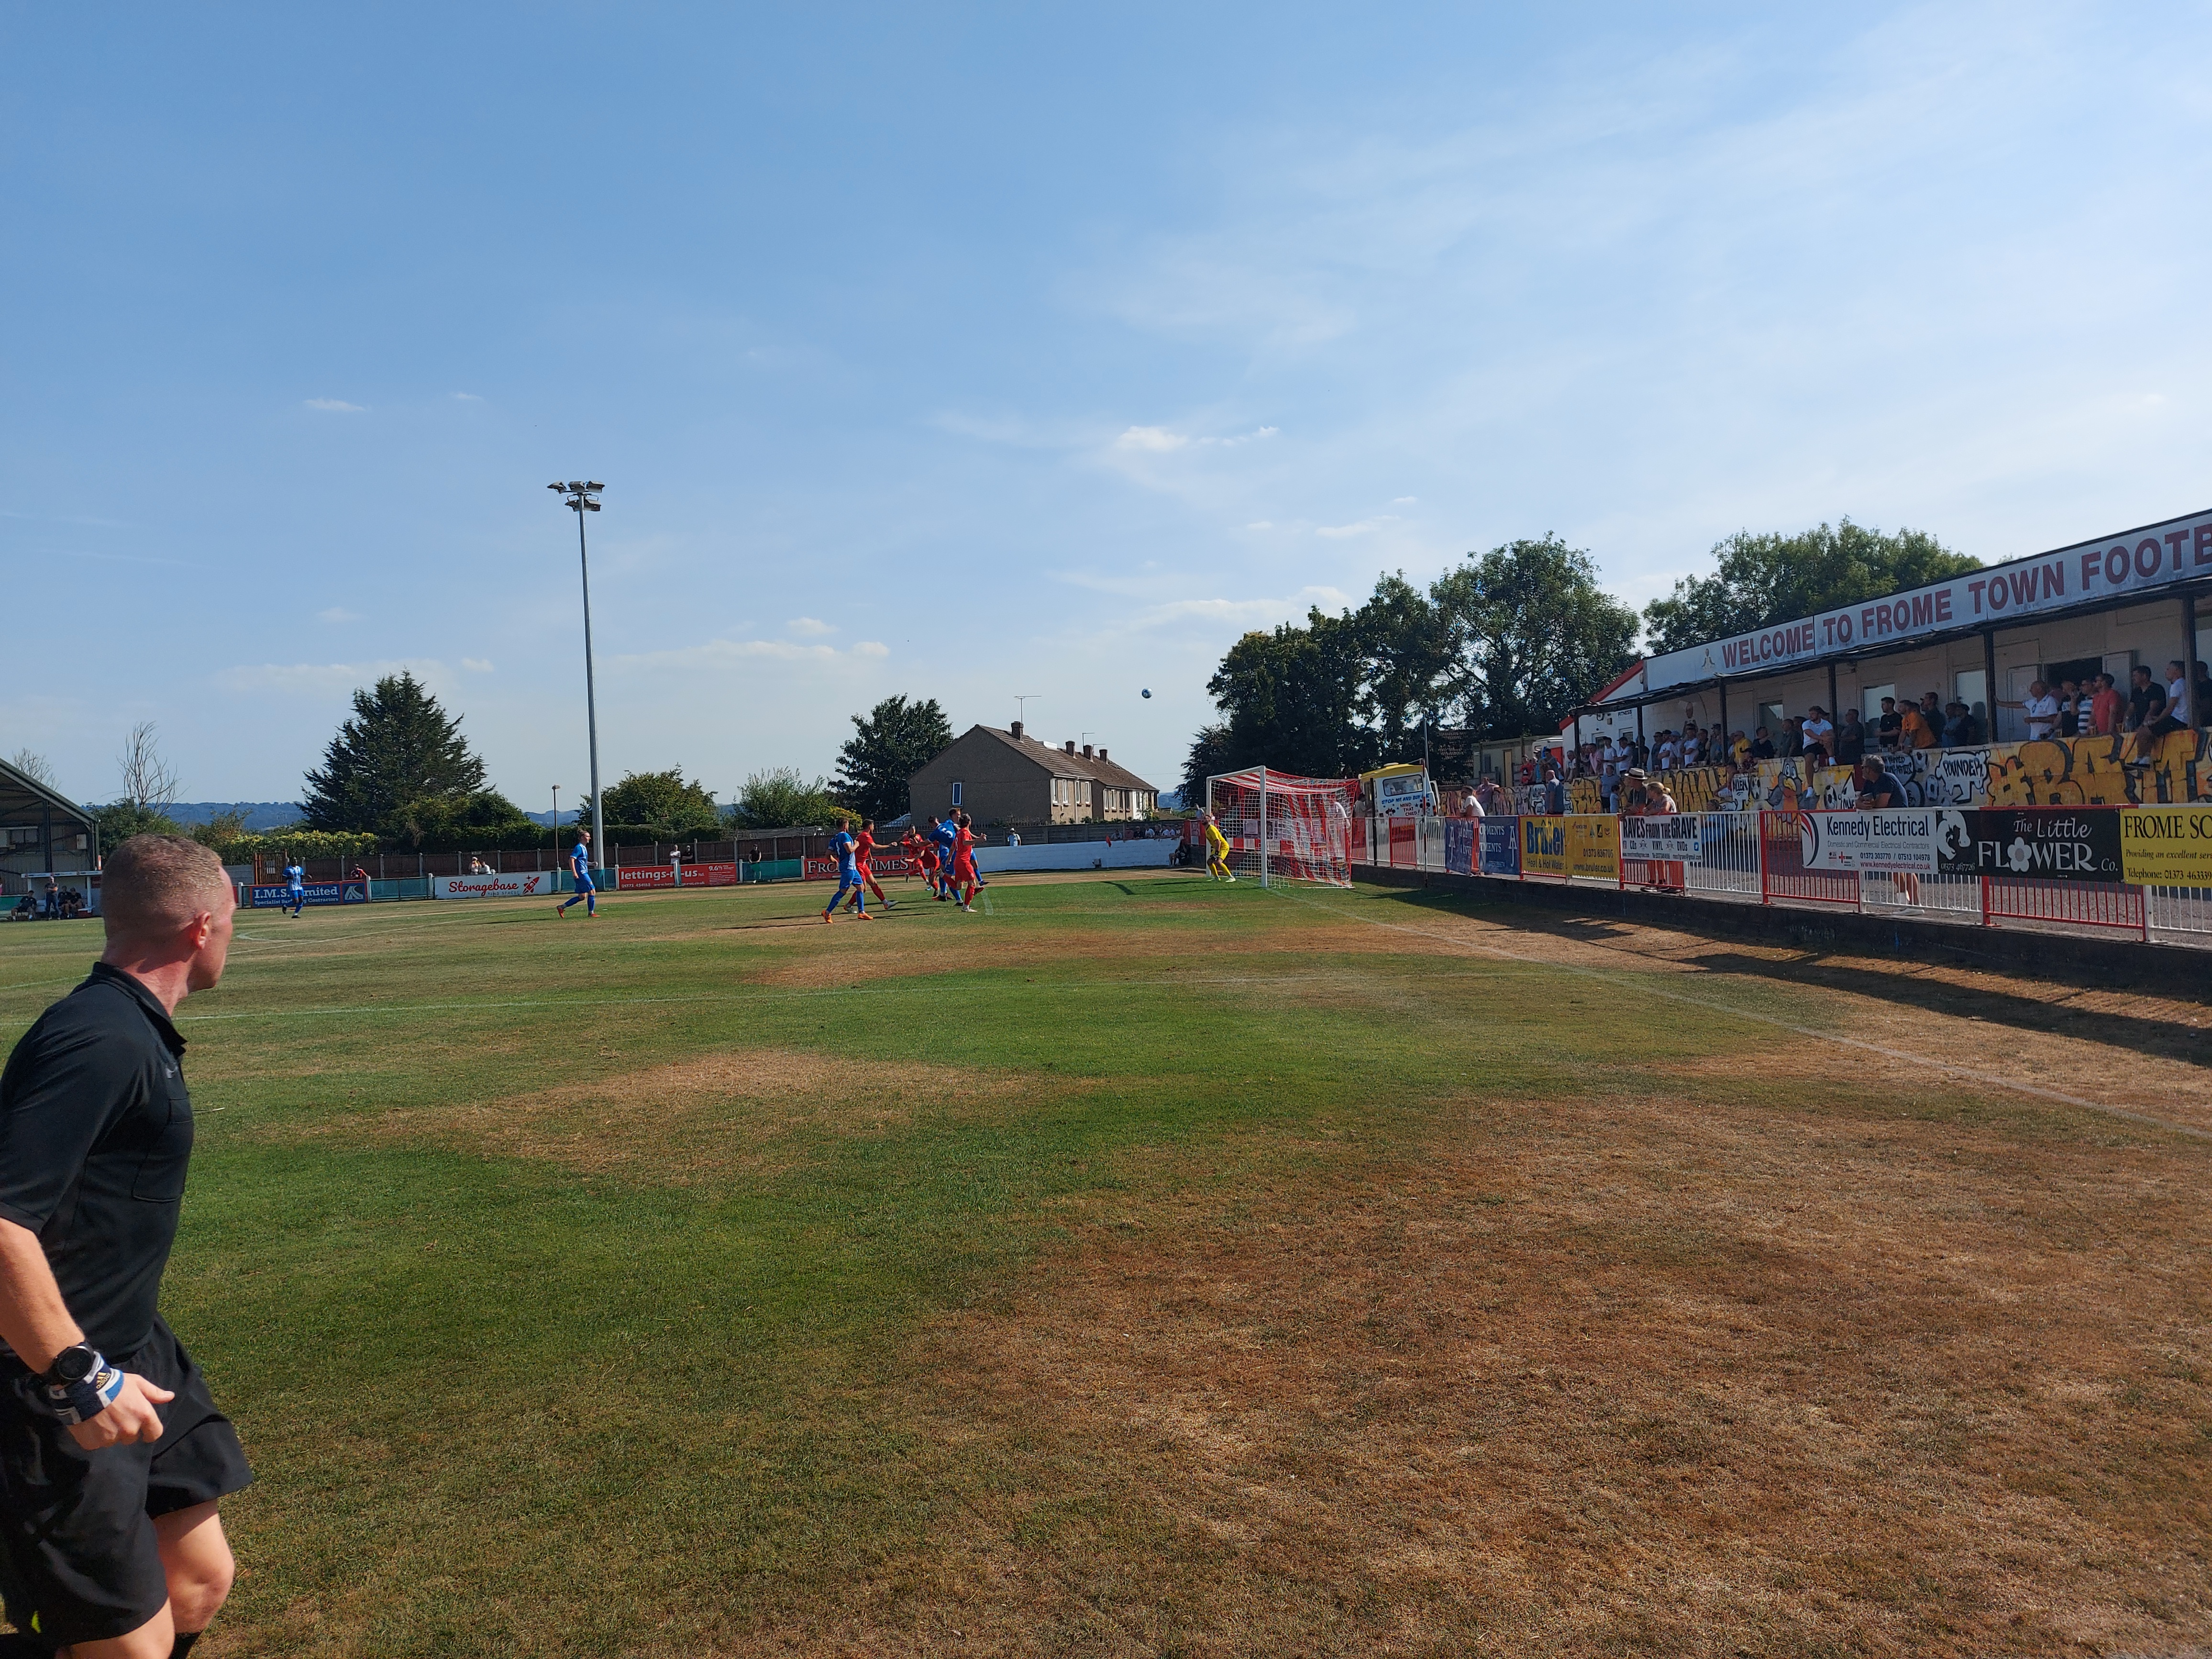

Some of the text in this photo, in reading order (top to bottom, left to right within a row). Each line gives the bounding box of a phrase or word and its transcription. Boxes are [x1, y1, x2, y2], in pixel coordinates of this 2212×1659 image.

[1723, 623, 1814, 667] WELCOME
[1823, 617, 1853, 646] TO
[1862, 589, 1953, 638] FROME
[1968, 561, 2065, 614] TOWN
[941, 828, 953, 838] 5
[1623, 817, 1698, 839] RAVES FROM THE GRAVE
[1826, 816, 1929, 841] Kennedy Electrical
[2013, 817, 2092, 838] The Little
[2124, 815, 2185, 839] FROME
[1583, 848, 1596, 857] 01373
[1652, 841, 1663, 851] VINYL
[2126, 849, 2154, 860] Providing
[2167, 850, 2197, 859] excellent
[1860, 862, 1931, 870] www.kennedyelectrical.co.uk
[1956, 863, 1975, 871] 467726
[2101, 858, 2118, 872] Co.
[2127, 867, 2212, 881] Telephone: 01373 463339
[254, 888, 290, 898] I.M.S.
[449, 878, 519, 896] Storagebase
[96, 1372, 111, 1389] adidas
